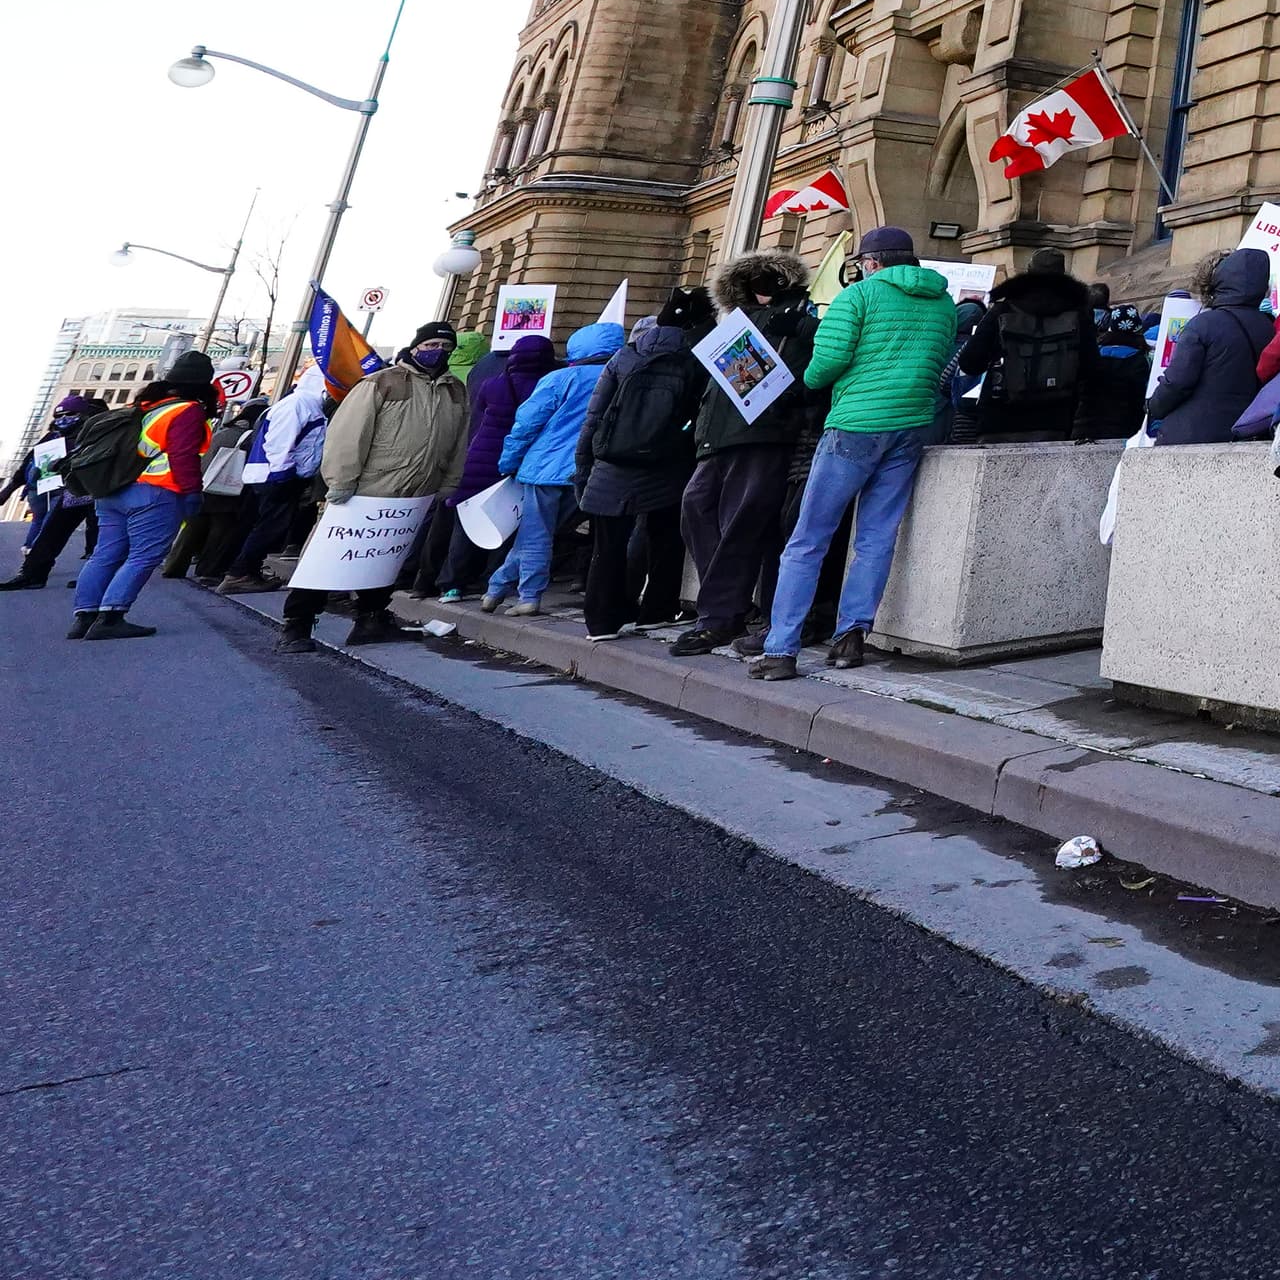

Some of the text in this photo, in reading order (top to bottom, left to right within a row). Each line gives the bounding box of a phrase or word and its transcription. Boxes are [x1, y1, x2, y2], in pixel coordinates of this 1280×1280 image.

[365, 506, 419, 521] JUST
[327, 523, 419, 540] TRANSITION
[340, 542, 410, 561] ALREADY
